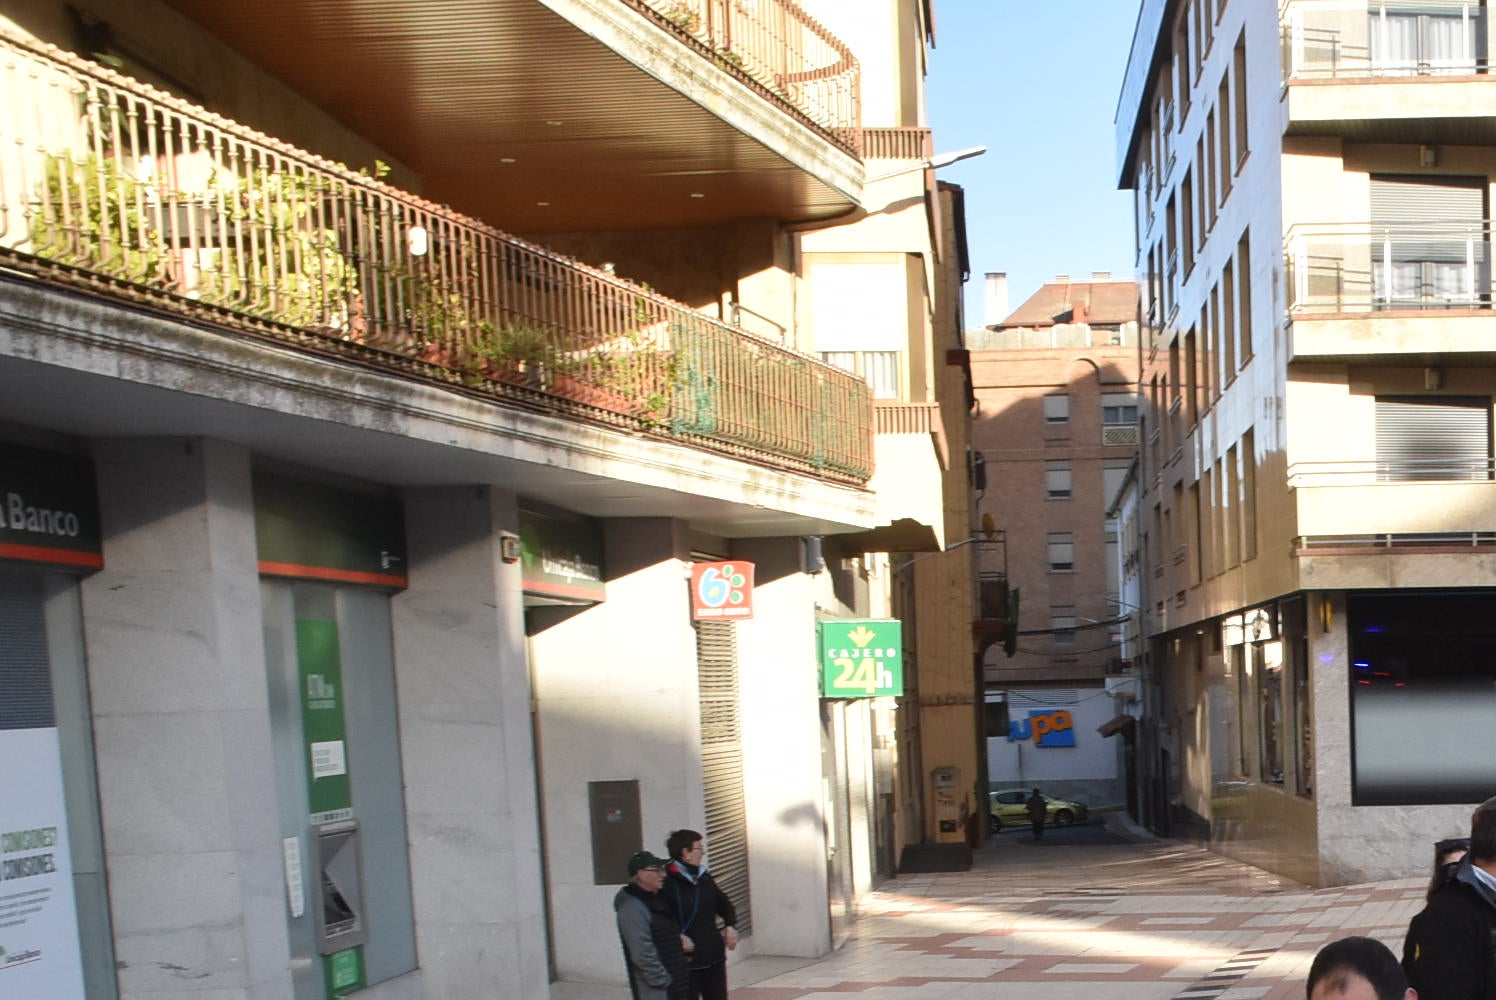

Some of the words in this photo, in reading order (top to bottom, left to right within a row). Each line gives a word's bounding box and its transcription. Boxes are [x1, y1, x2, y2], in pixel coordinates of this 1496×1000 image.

[7, 492, 79, 537] Banco
[828, 648, 897, 658] CAJERO
[832, 657, 894, 693] 24h
